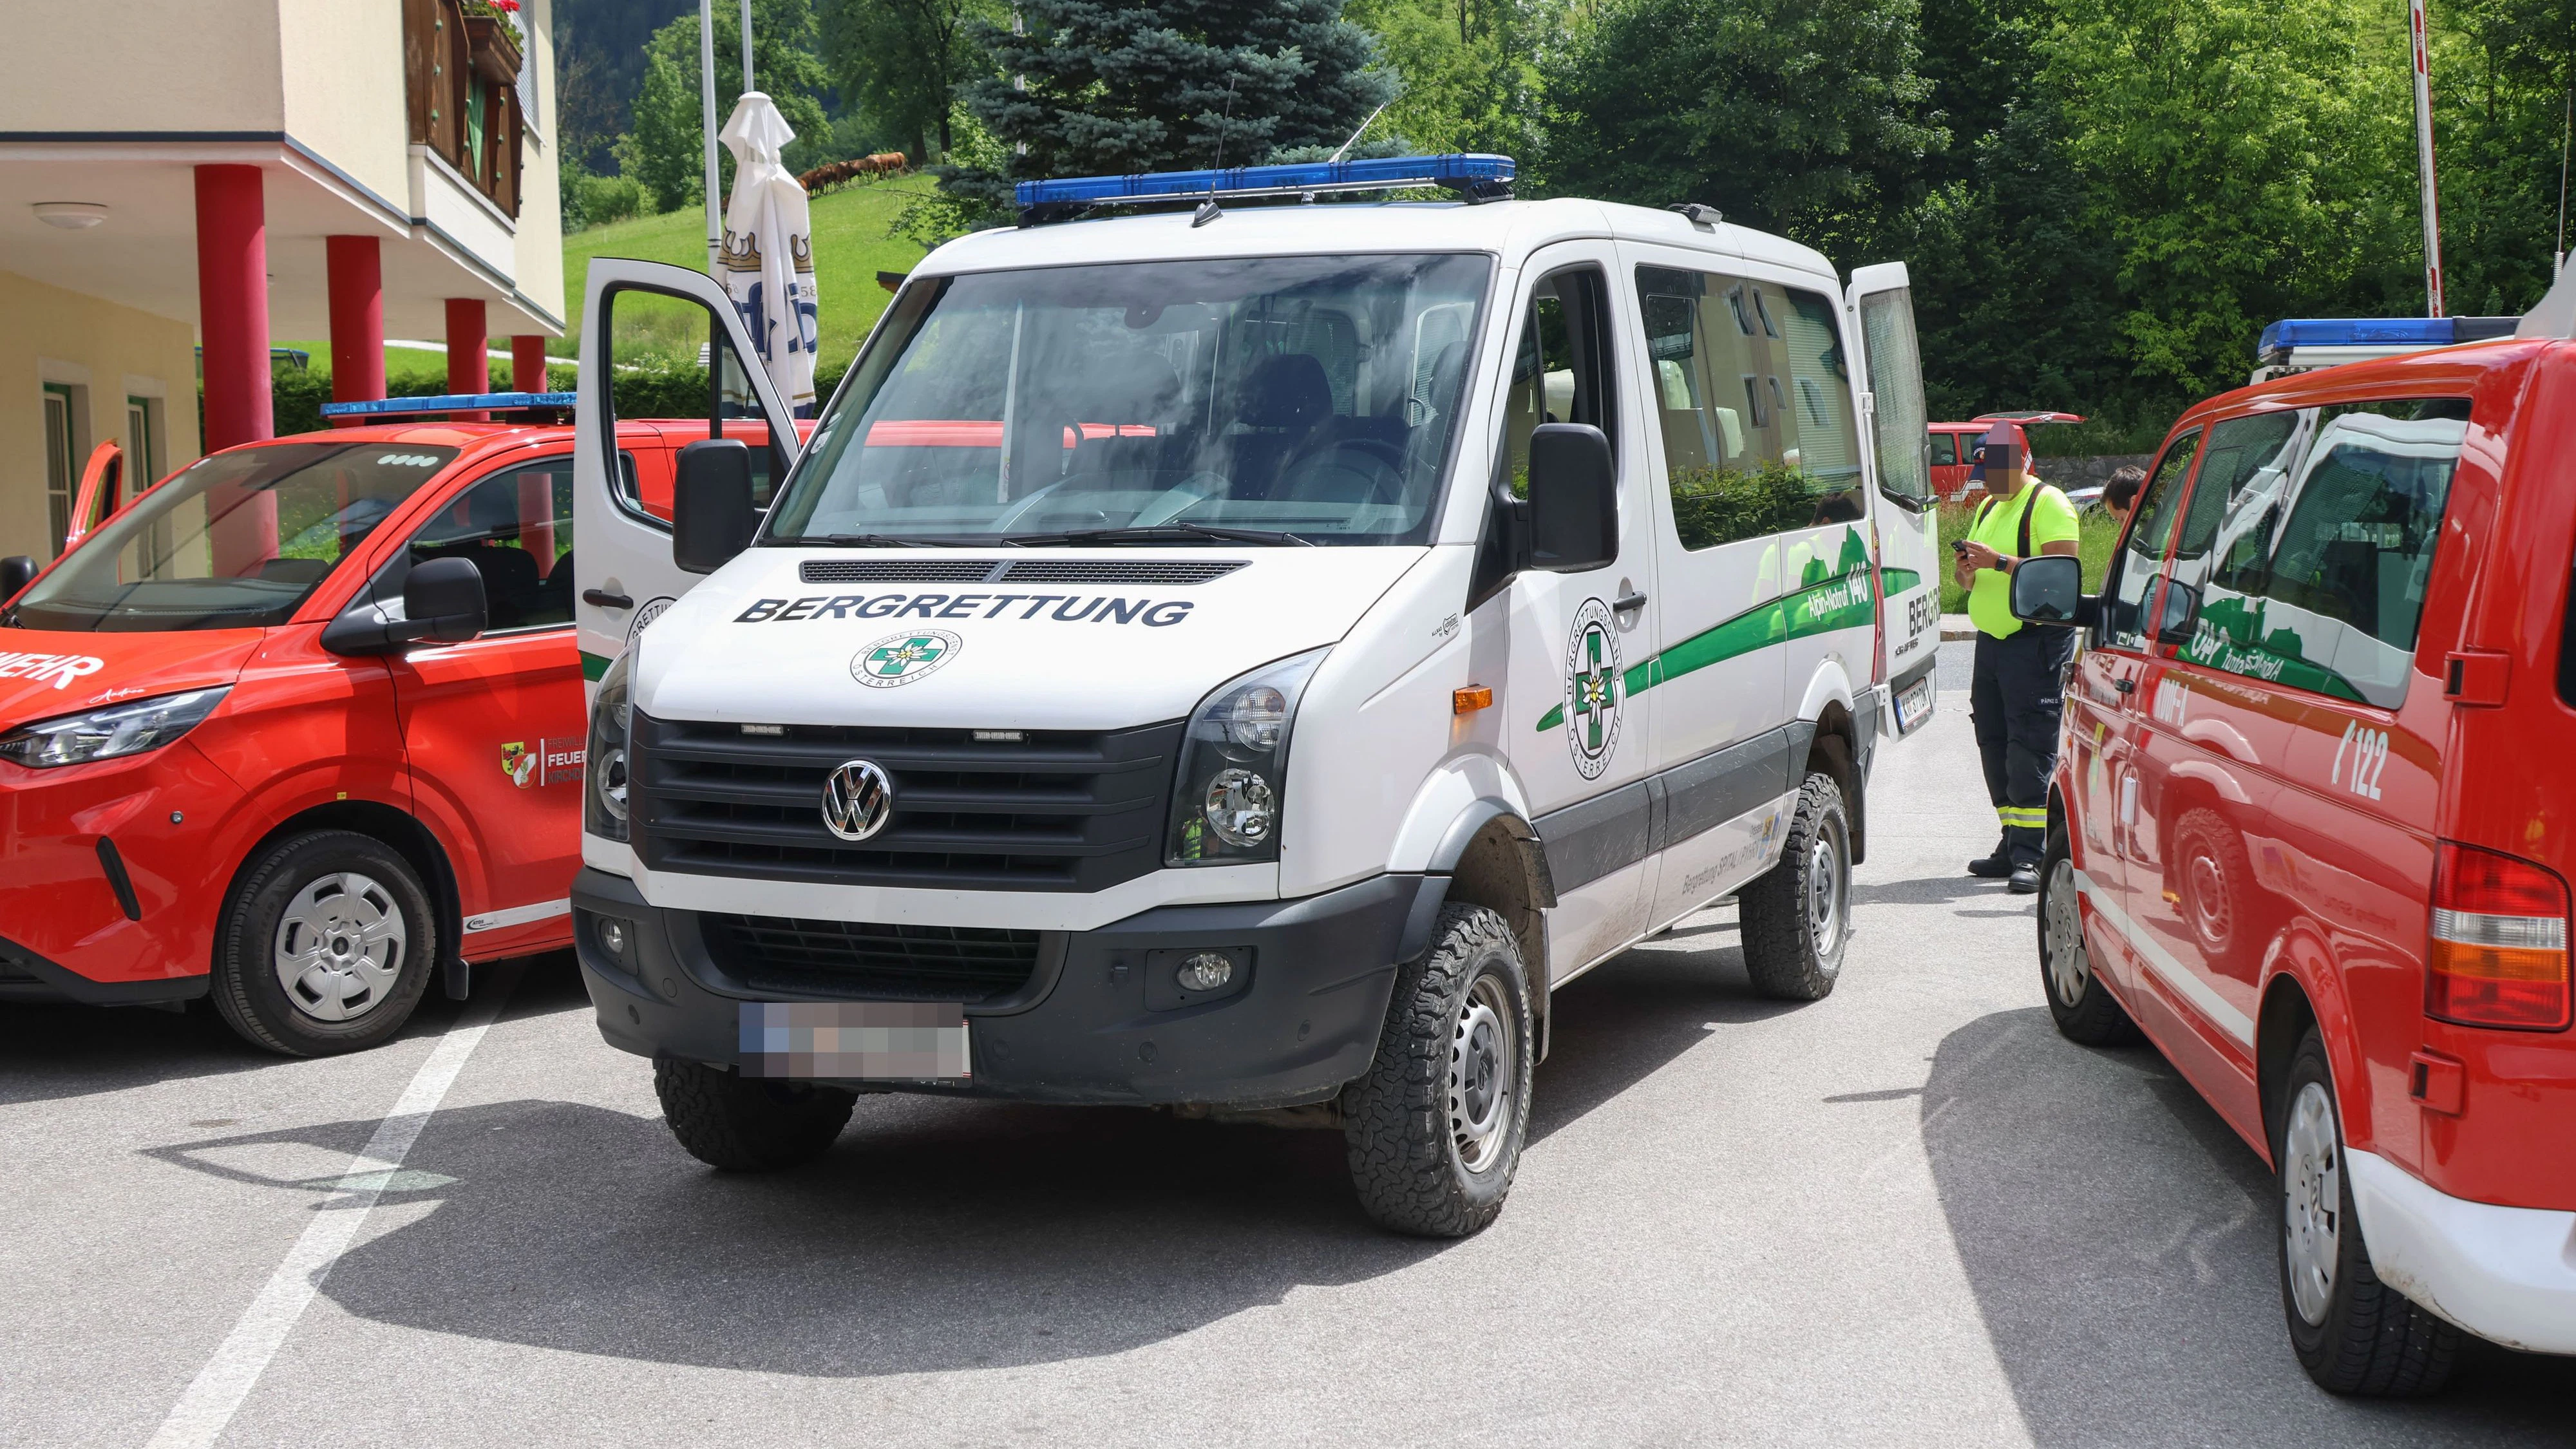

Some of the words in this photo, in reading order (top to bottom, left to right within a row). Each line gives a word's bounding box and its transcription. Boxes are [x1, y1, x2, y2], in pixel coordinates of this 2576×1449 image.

[732, 594, 1195, 627] BERGRETTUNG
[1808, 583, 1849, 621] Alpin-Notruf
[1846, 560, 1868, 605] 140
[861, 630, 958, 656] BERGRETTUNGSDIENST
[1566, 605, 1621, 696] BERGRETTUNGSDIENST
[853, 664, 938, 687] ÖSTERREICH
[1569, 715, 1621, 777] ÖSTERREICH
[2350, 726, 2389, 801] 122
